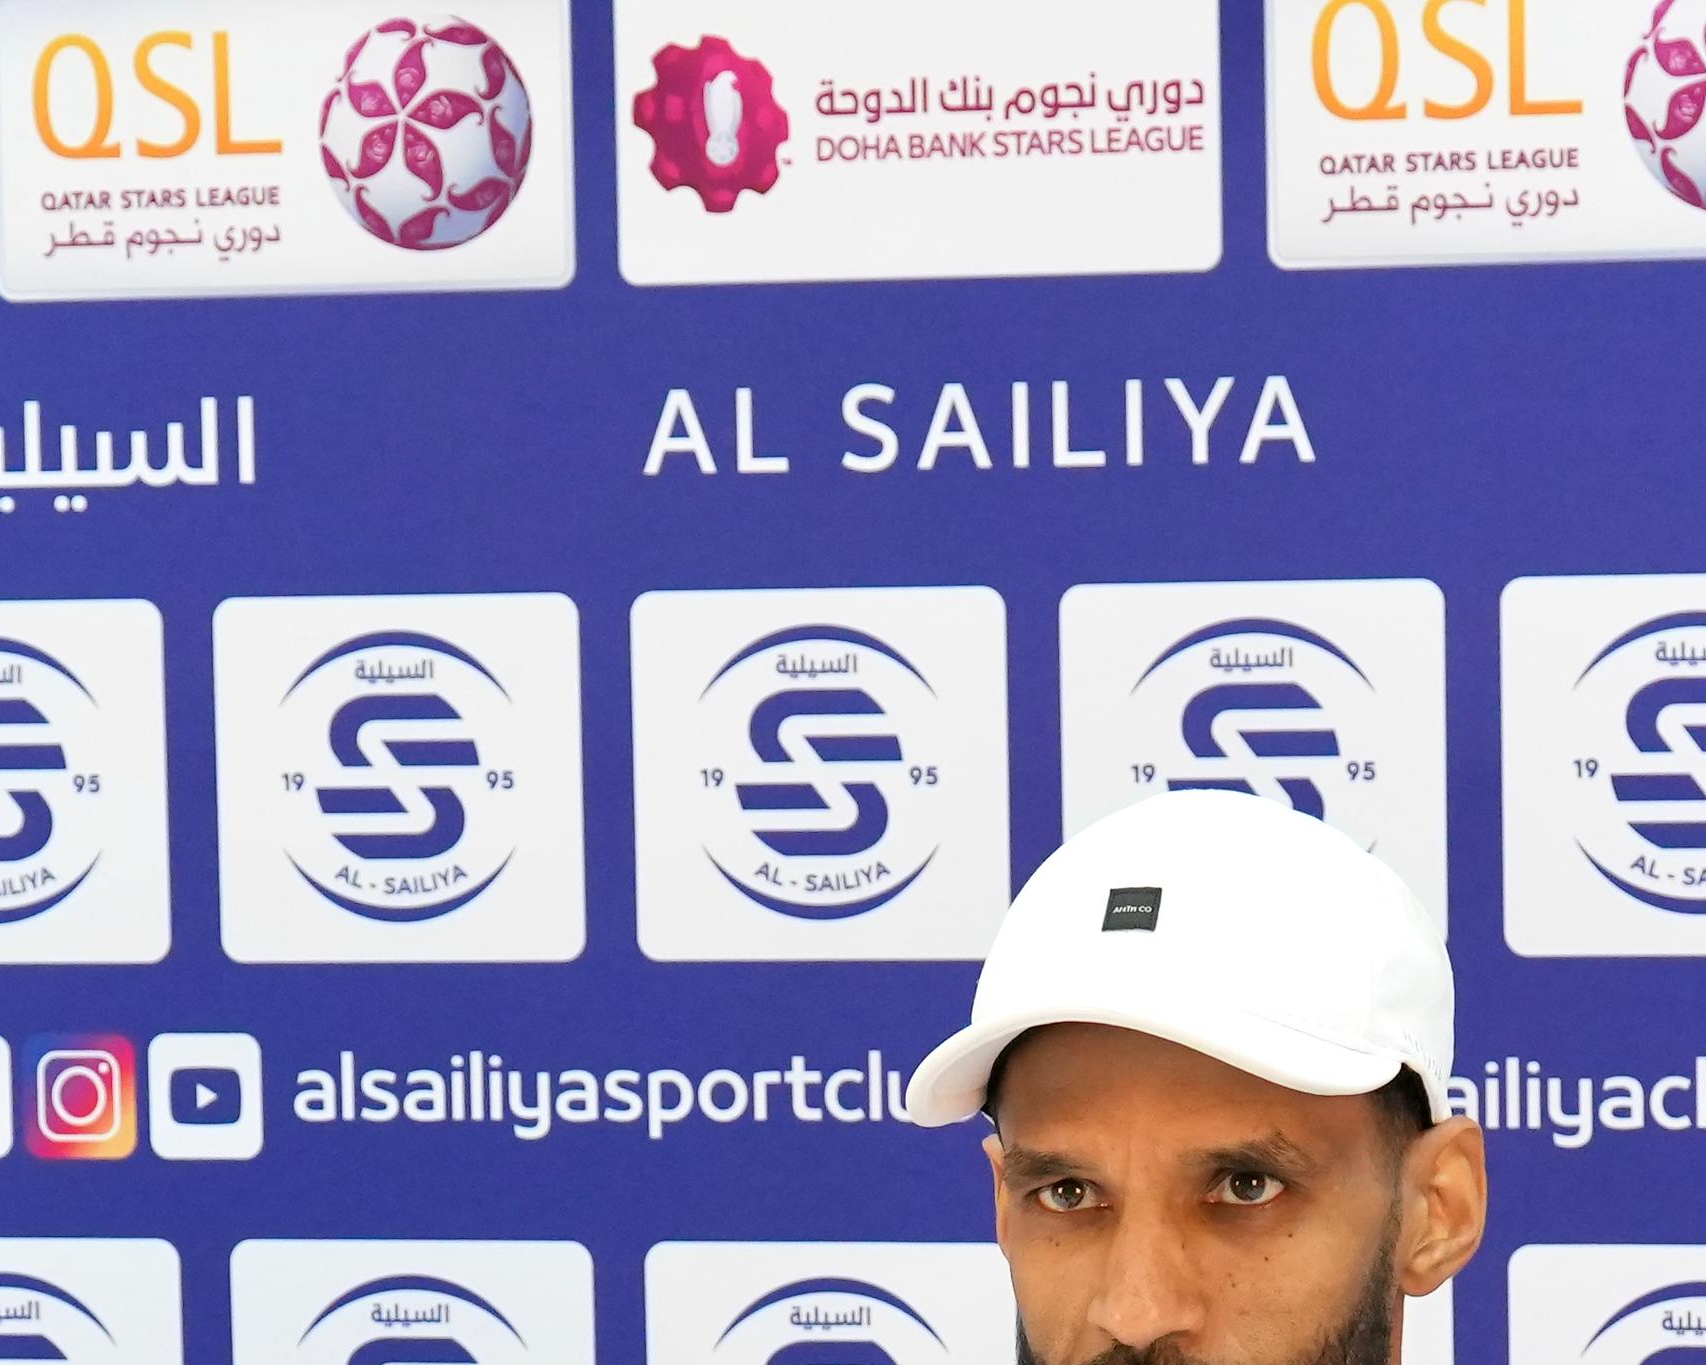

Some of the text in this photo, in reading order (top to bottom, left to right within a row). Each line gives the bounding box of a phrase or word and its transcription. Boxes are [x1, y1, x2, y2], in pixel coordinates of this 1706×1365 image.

[1312, 0, 1583, 121] QSL
[33, 31, 283, 159] QSL
[814, 73, 1206, 125] دوري نجوم بنك الدوحة
[815, 125, 1205, 163] DOHA BANK STARS LEAGUE
[1318, 148, 1580, 176] QATAR STARS LEAGUE
[40, 186, 280, 212] QATAR STARS LEAGUE
[1321, 180, 1580, 228] دوري نجوم قطر
[44, 220, 282, 262] دوري نجوم قطر
[644, 376, 1315, 475] AL SAILIYA
